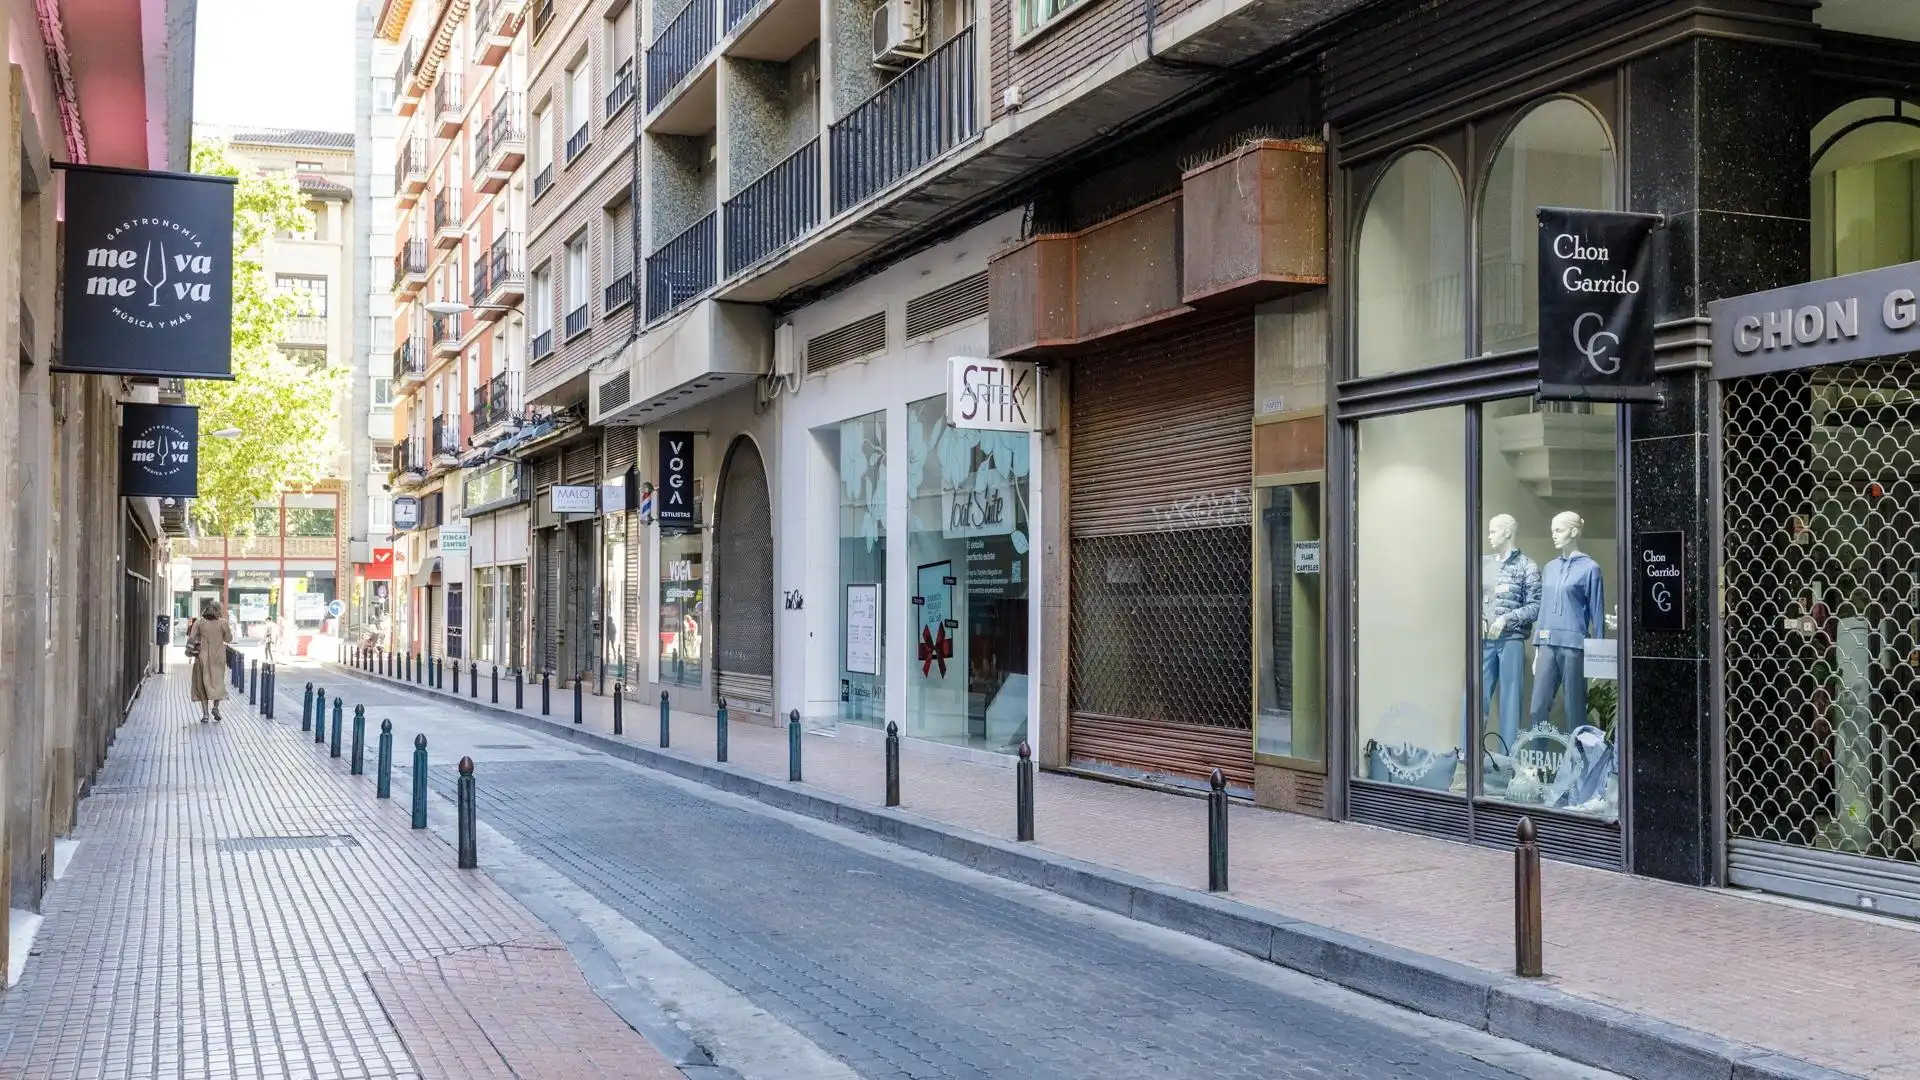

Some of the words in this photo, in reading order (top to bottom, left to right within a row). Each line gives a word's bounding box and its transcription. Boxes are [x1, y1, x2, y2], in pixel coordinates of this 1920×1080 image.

[107, 218, 202, 248] GASTRONOMÍA
[1553, 234, 1609, 260] Chon
[87, 247, 137, 269] me
[174, 254, 212, 274] va
[87, 276, 137, 297] me
[174, 282, 211, 302] va
[1563, 266, 1640, 294] Garrido
[113, 307, 154, 329] MÚSICA
[170, 313, 192, 327] MÁS
[1733, 297, 1858, 353] CHON
[962, 365, 1029, 424] STIK
[132, 440, 155, 449] me
[171, 441, 189, 450] va
[132, 452, 155, 462] me
[171, 454, 189, 463] va
[669, 441, 684, 505] VOGA
[557, 489, 590, 499] MALO
[1643, 550, 1666, 562] Chon
[1647, 564, 1680, 577] Garrido
[1520, 748, 1571, 775] REBAJA
